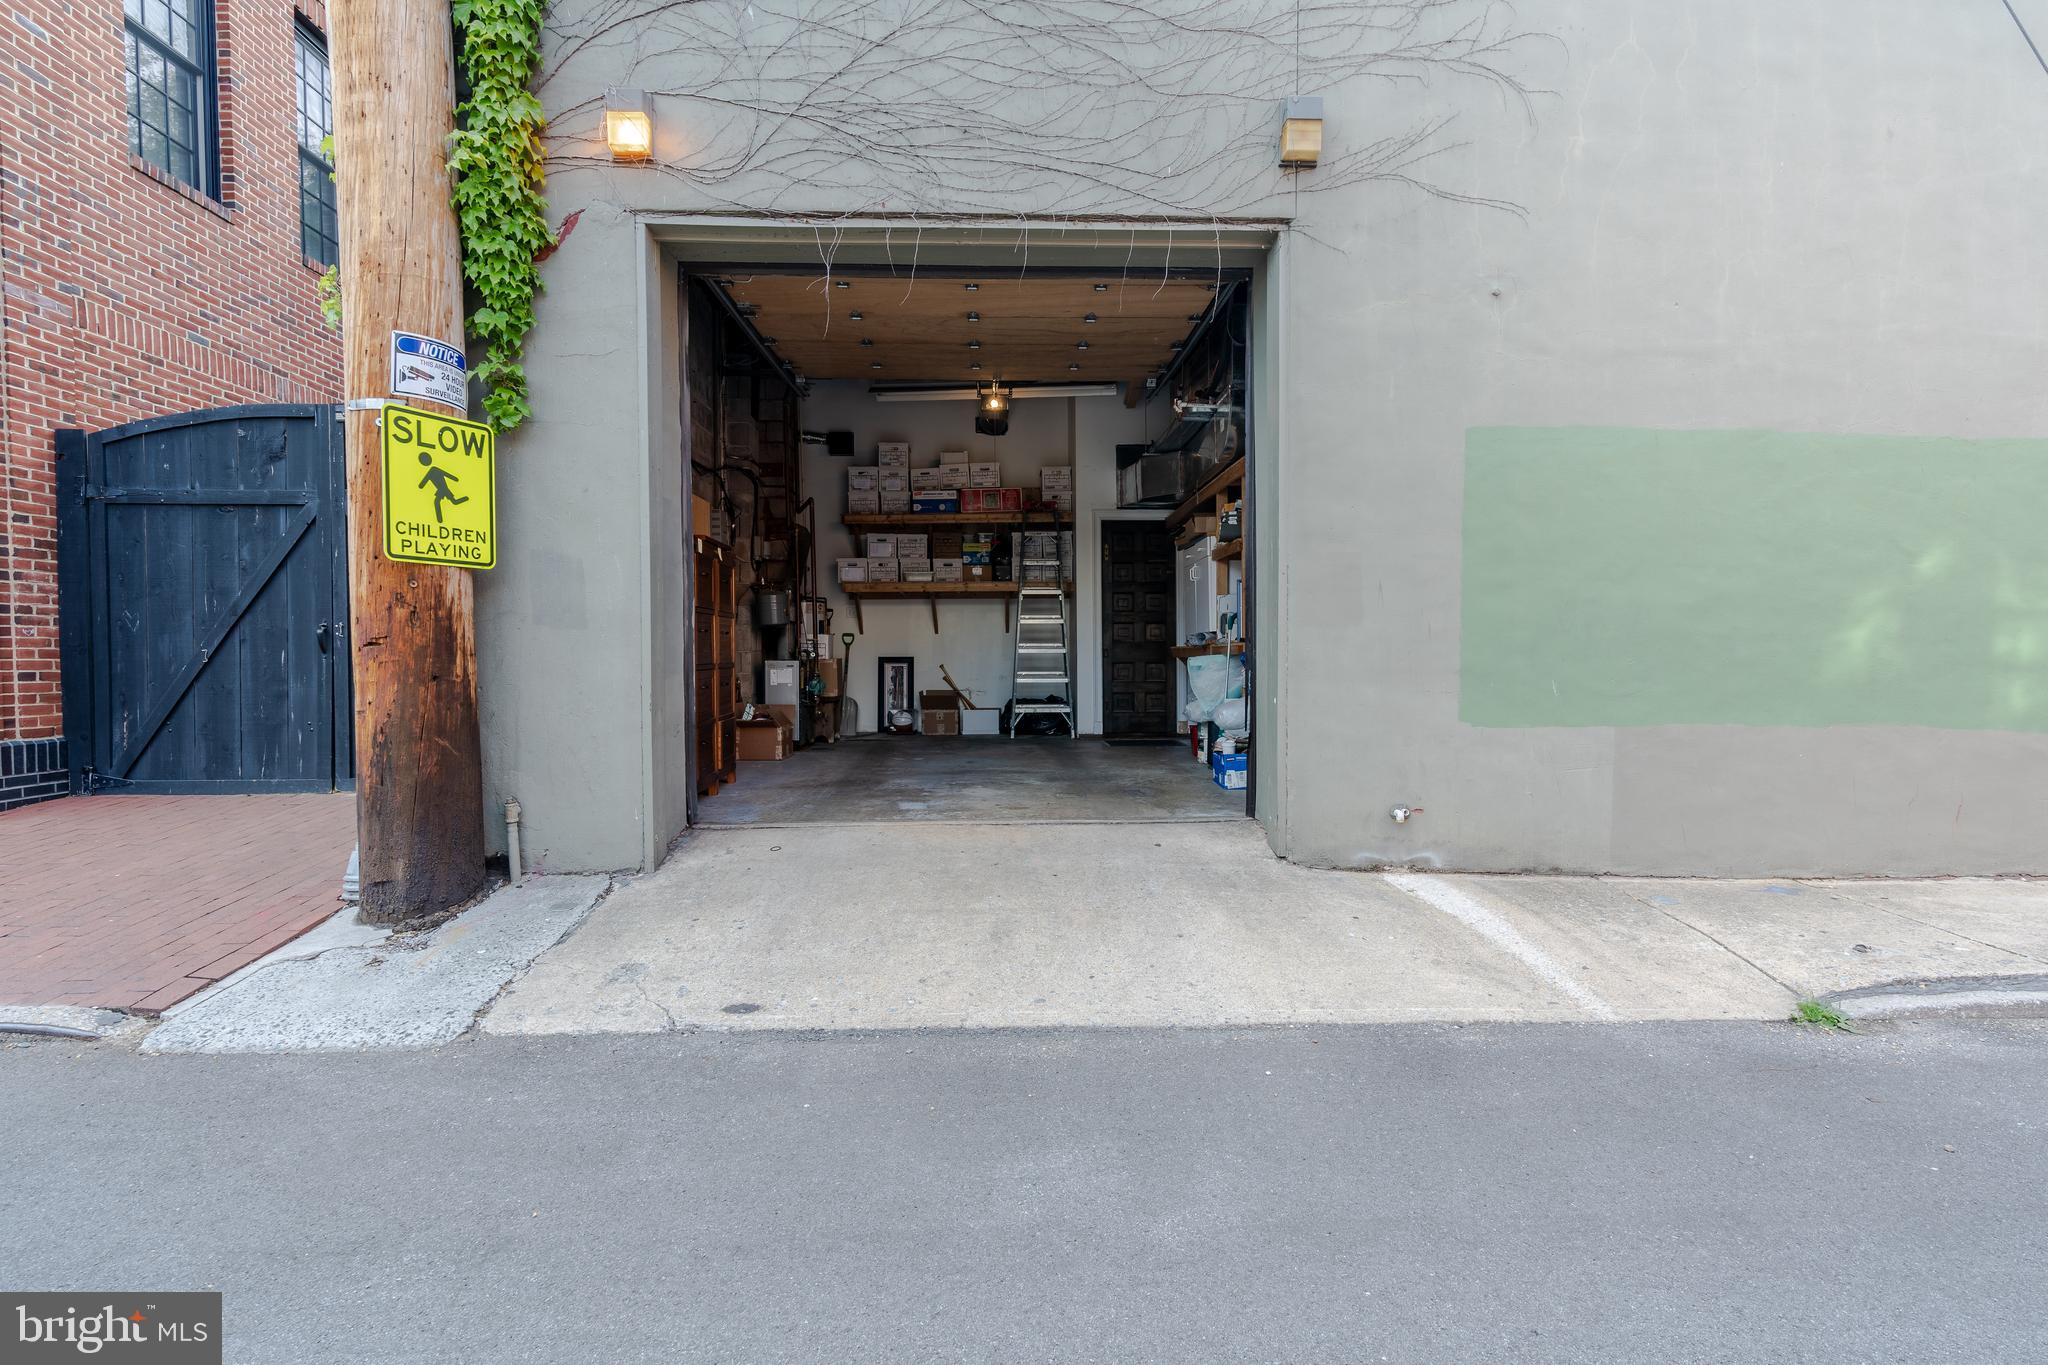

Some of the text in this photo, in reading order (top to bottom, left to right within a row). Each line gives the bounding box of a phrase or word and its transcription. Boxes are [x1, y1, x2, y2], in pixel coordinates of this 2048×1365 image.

[419, 342, 459, 365] NOTICE
[435, 363, 449, 372] AREA
[441, 372, 450, 381] 24
[445, 383, 463, 397] VIDEO
[392, 416, 485, 458] SLOW
[395, 521, 486, 544] CHILDREN
[401, 540, 481, 559] PLAYING
